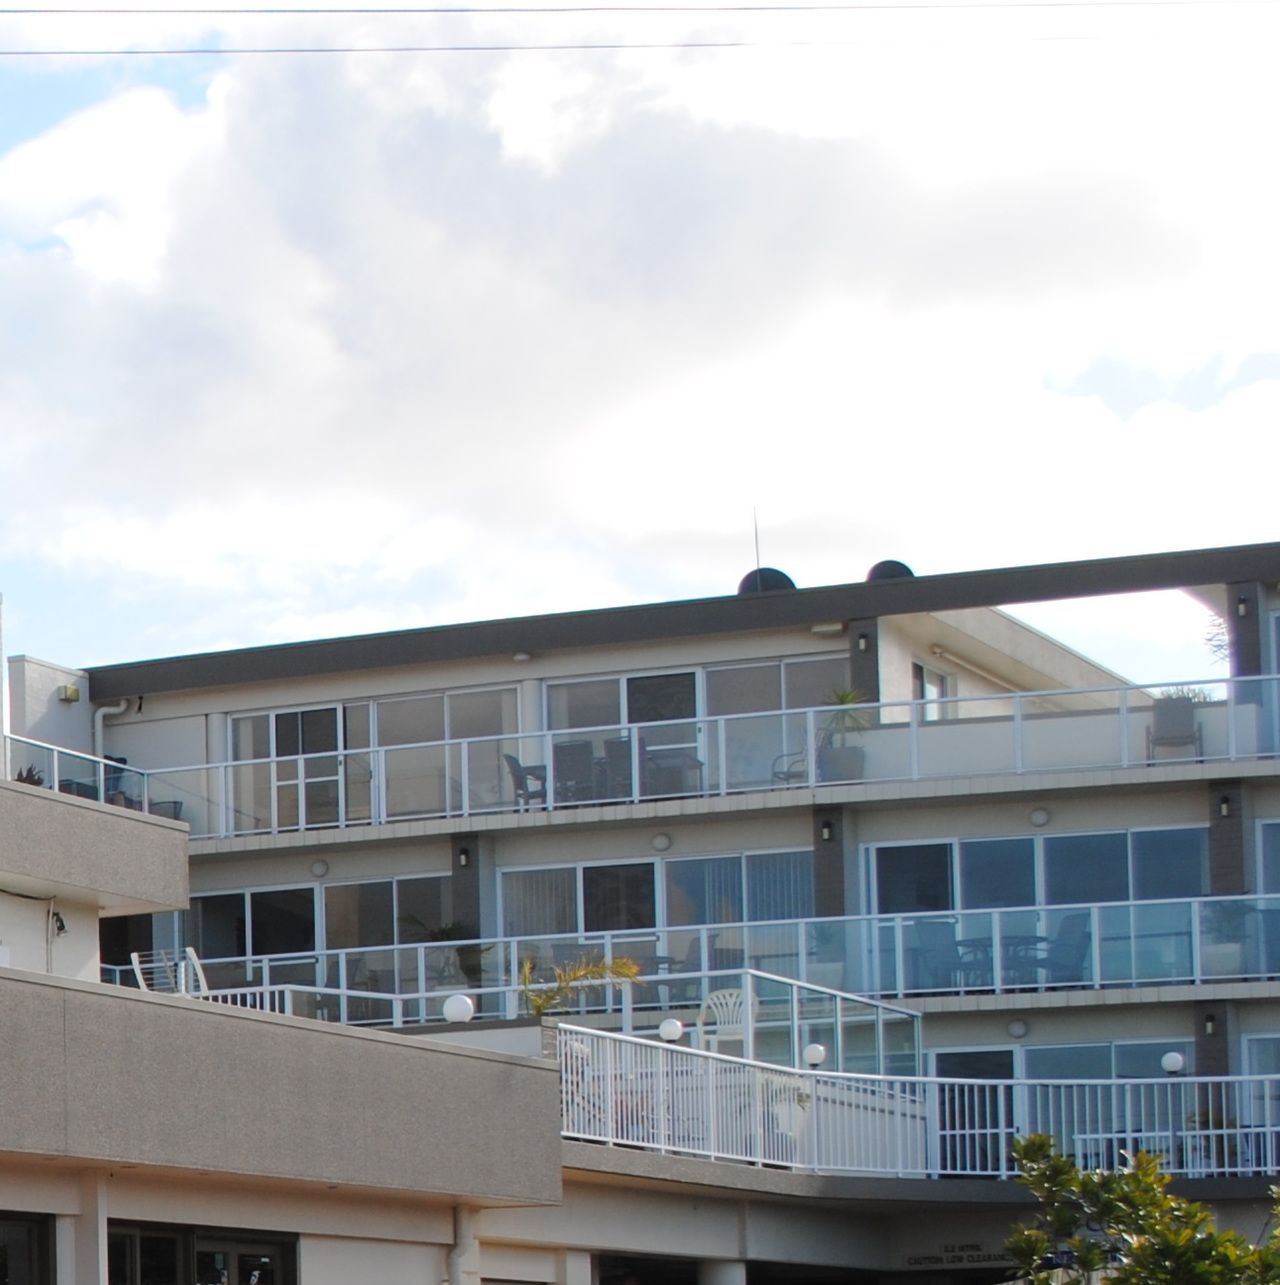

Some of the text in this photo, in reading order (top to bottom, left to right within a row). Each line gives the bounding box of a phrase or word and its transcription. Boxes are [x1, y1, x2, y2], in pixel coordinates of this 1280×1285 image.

[907, 1253, 1014, 1266] CAUTION LOW CLEARANC
